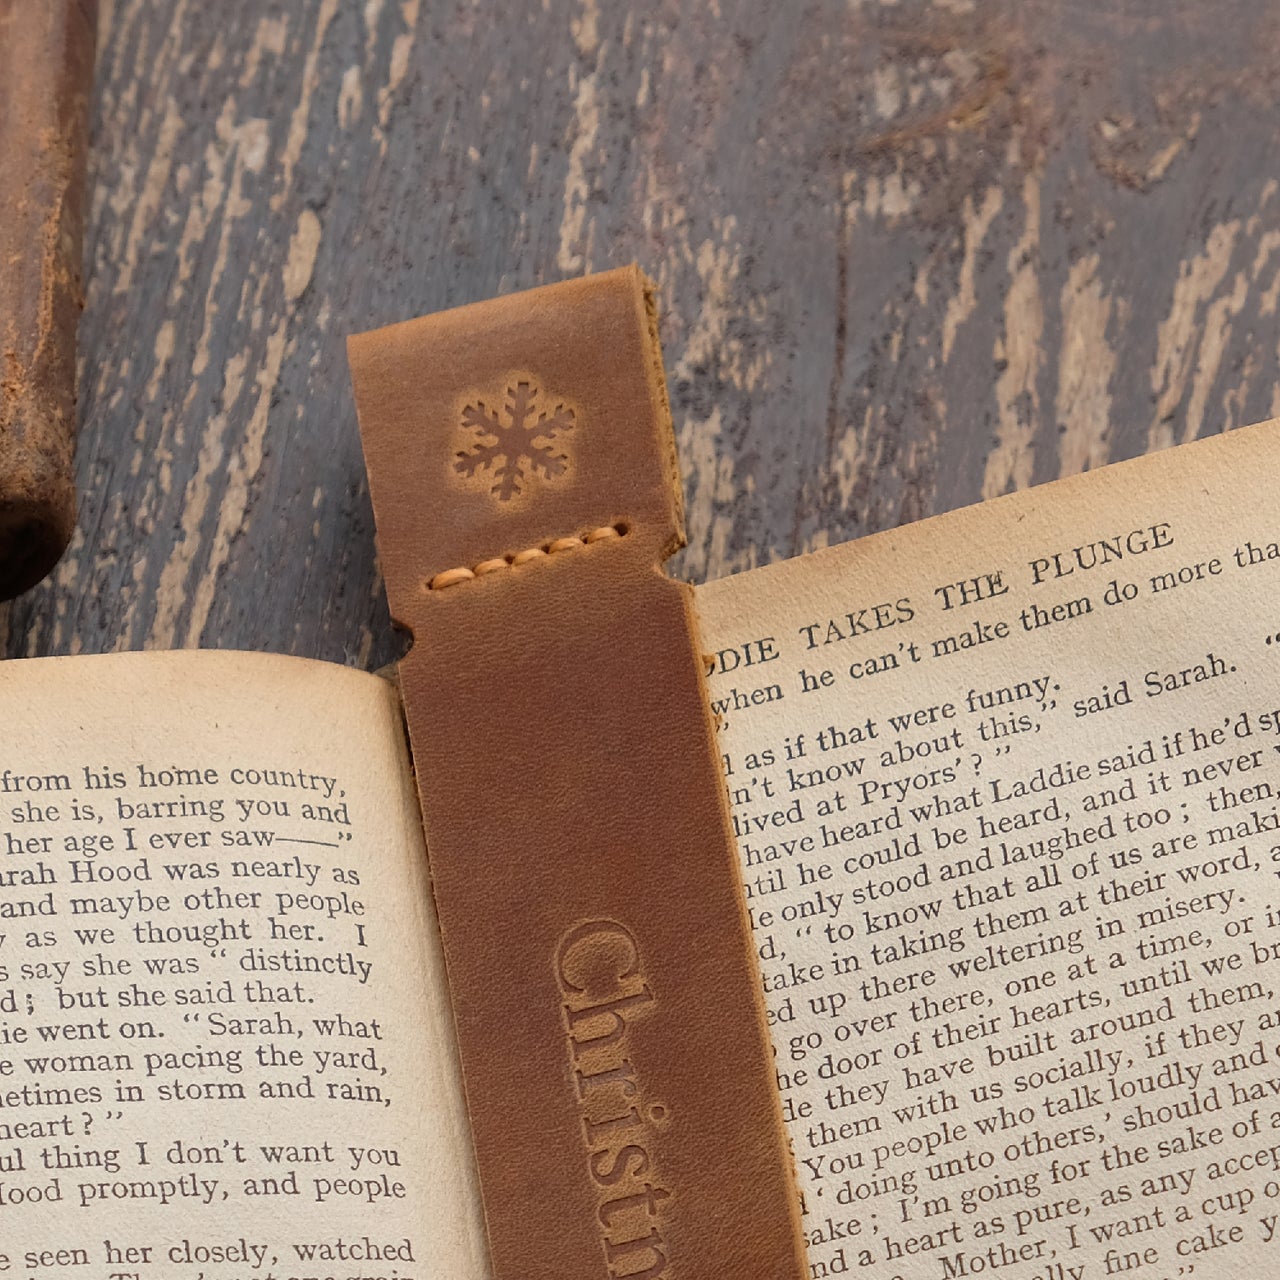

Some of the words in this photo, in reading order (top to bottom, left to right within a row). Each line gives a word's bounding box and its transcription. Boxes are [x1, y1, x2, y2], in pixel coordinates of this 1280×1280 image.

[705, 636, 780, 677] DIE
[797, 596, 916, 652] TAKES
[932, 568, 1011, 612] THE
[1026, 521, 1176, 587] PLUNGE
[711, 683, 784, 715] when
[796, 667, 837, 695] he
[929, 619, 1012, 659] make
[1017, 595, 1096, 633] them
[1102, 578, 1140, 607] do
[1147, 557, 1224, 595] more
[10, 798, 62, 825] she
[69, 803, 105, 826] is,
[113, 795, 227, 824] barring
[234, 798, 292, 824] you
[300, 801, 353, 827] and
[806, 991, 848, 1020] up
[857, 968, 938, 1004] there
[946, 928, 1086, 981] weltering
[1094, 915, 1127, 942] in
[1132, 887, 1247, 935] misery.
[22, 1053, 136, 1076] woman
[142, 1043, 245, 1079] pacing
[253, 1041, 305, 1068] the
[311, 1046, 389, 1078] yard,
[823, 1078, 891, 1112] they
[900, 1056, 976, 1092] have
[983, 1029, 1059, 1069] built
[1069, 995, 1178, 1046] around
[1185, 981, 1275, 1015] them,
[1063, 1222, 1083, 1252] I
[1087, 1204, 1168, 1245] want
[1173, 1204, 1195, 1224] a
[1200, 1187, 1256, 1217] cup
